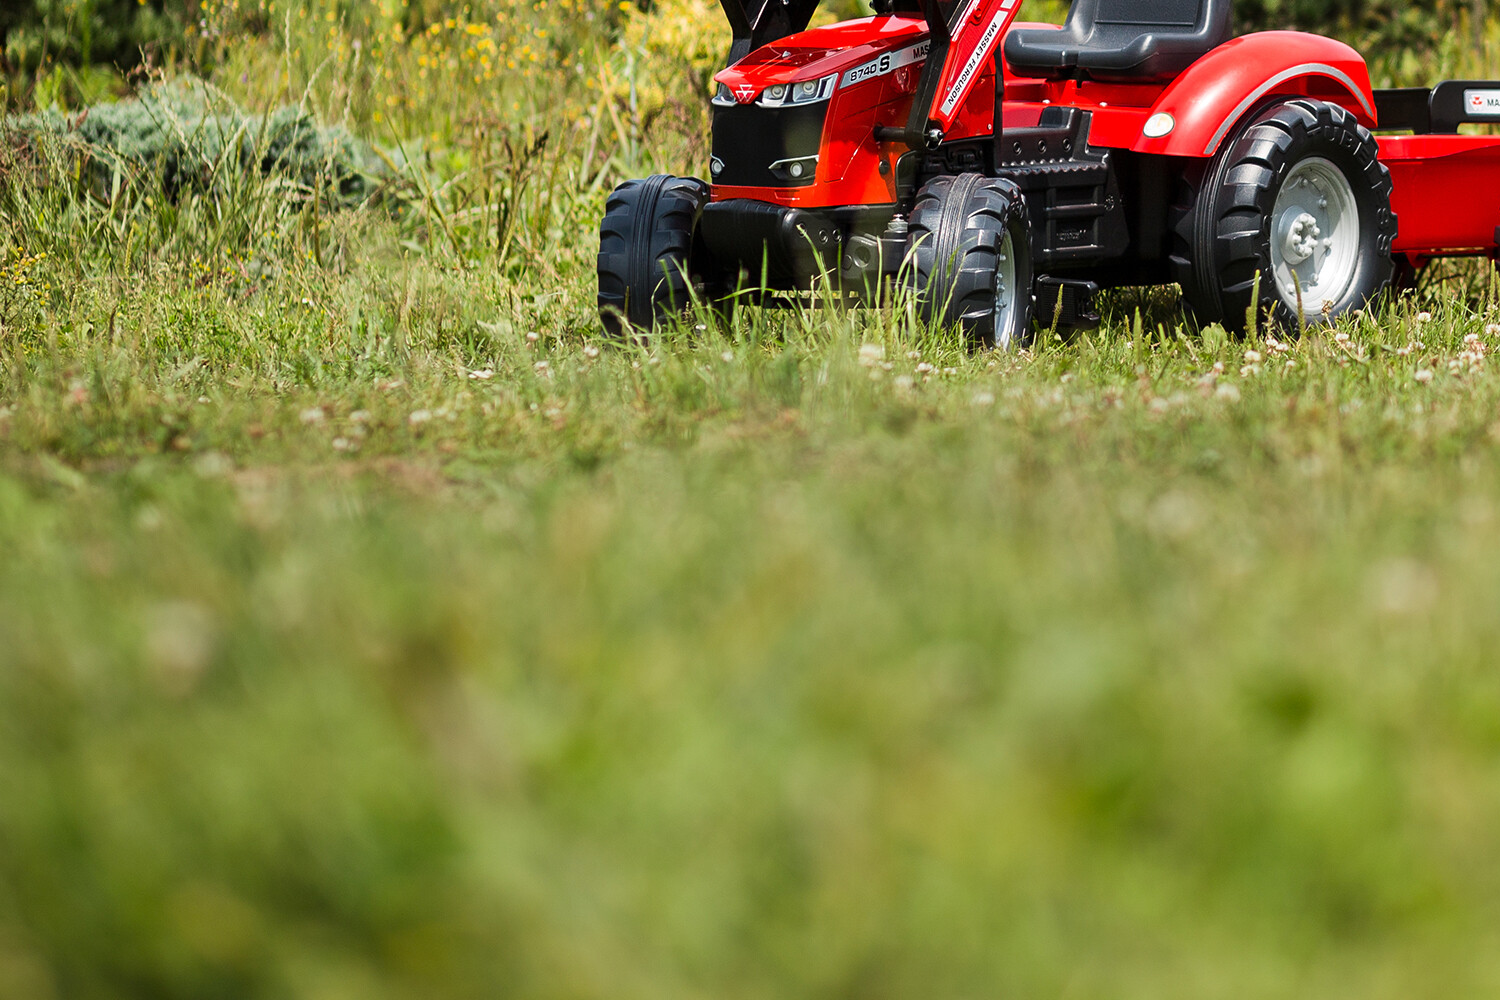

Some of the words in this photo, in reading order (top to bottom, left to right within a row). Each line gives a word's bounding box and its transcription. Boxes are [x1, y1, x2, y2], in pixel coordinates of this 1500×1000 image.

[976, 22, 998, 59] MASSEY
[850, 63, 877, 81] 8740
[879, 55, 890, 72] S
[948, 58, 976, 105] FERGUSON
